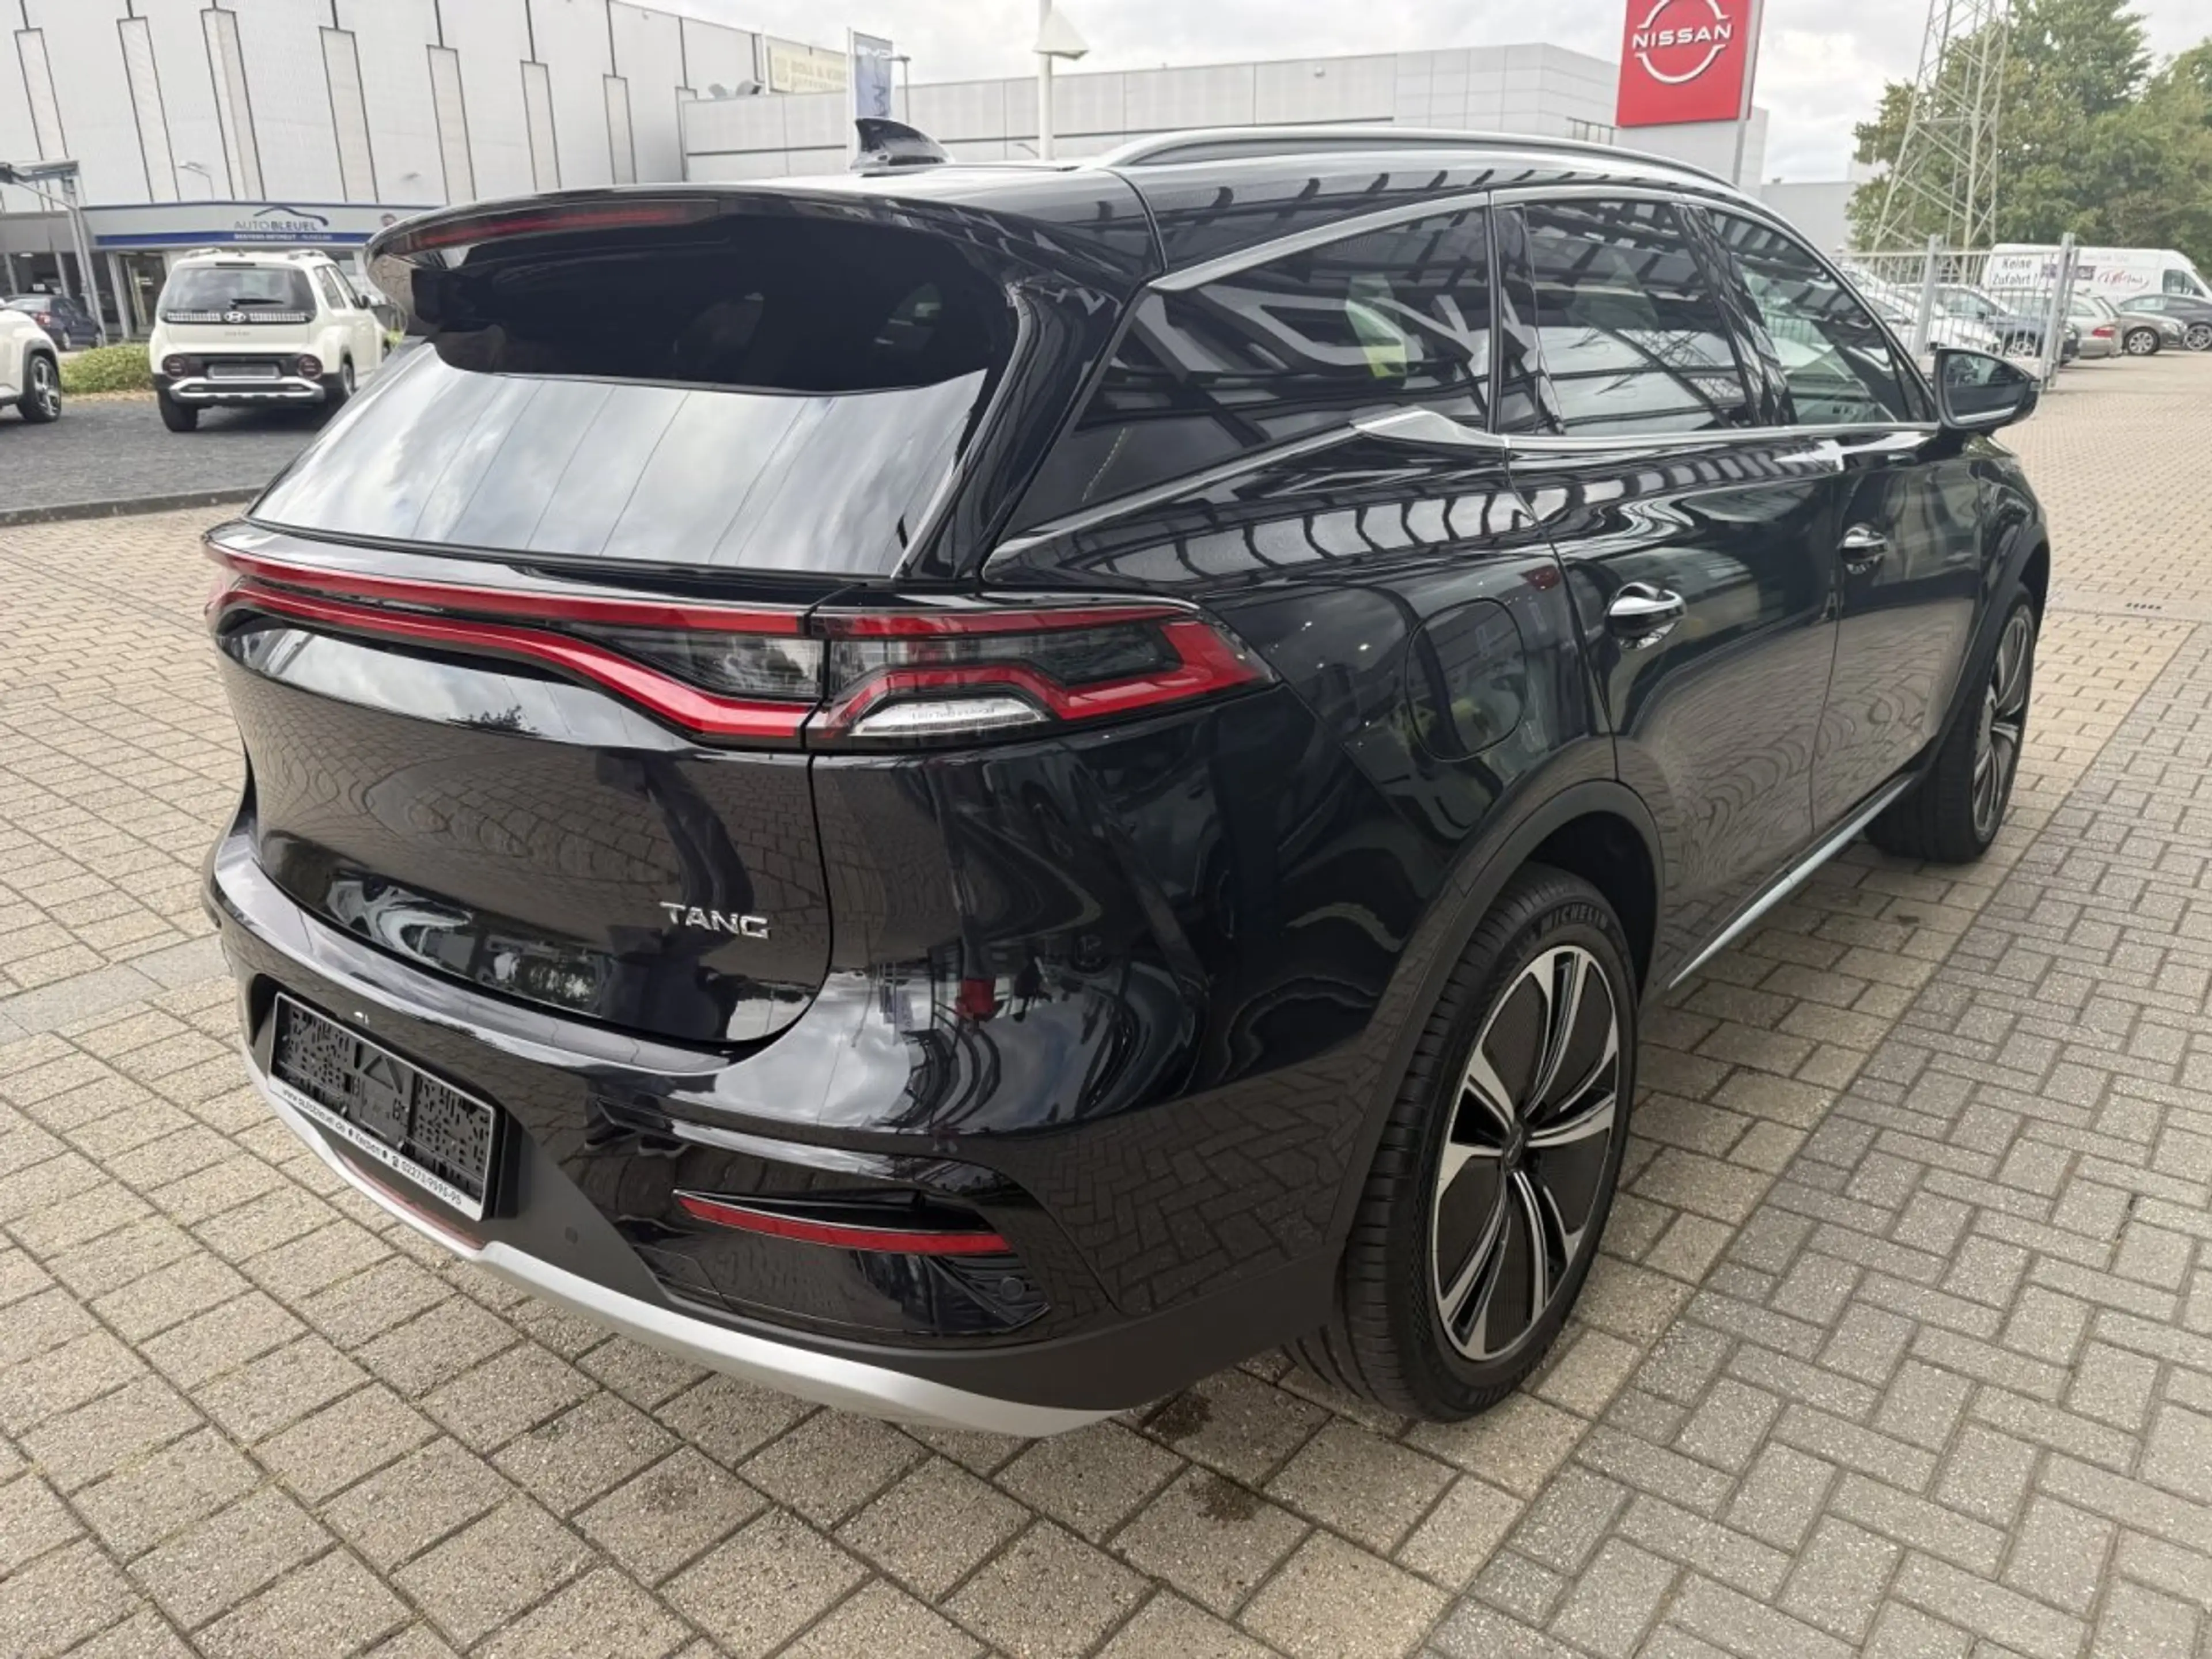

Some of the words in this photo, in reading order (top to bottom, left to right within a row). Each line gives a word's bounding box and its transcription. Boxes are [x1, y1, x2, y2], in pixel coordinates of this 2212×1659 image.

[1632, 24, 1732, 50] NISSAN
[2001, 257, 2032, 270] Keine
[660, 901, 768, 940] TANG
